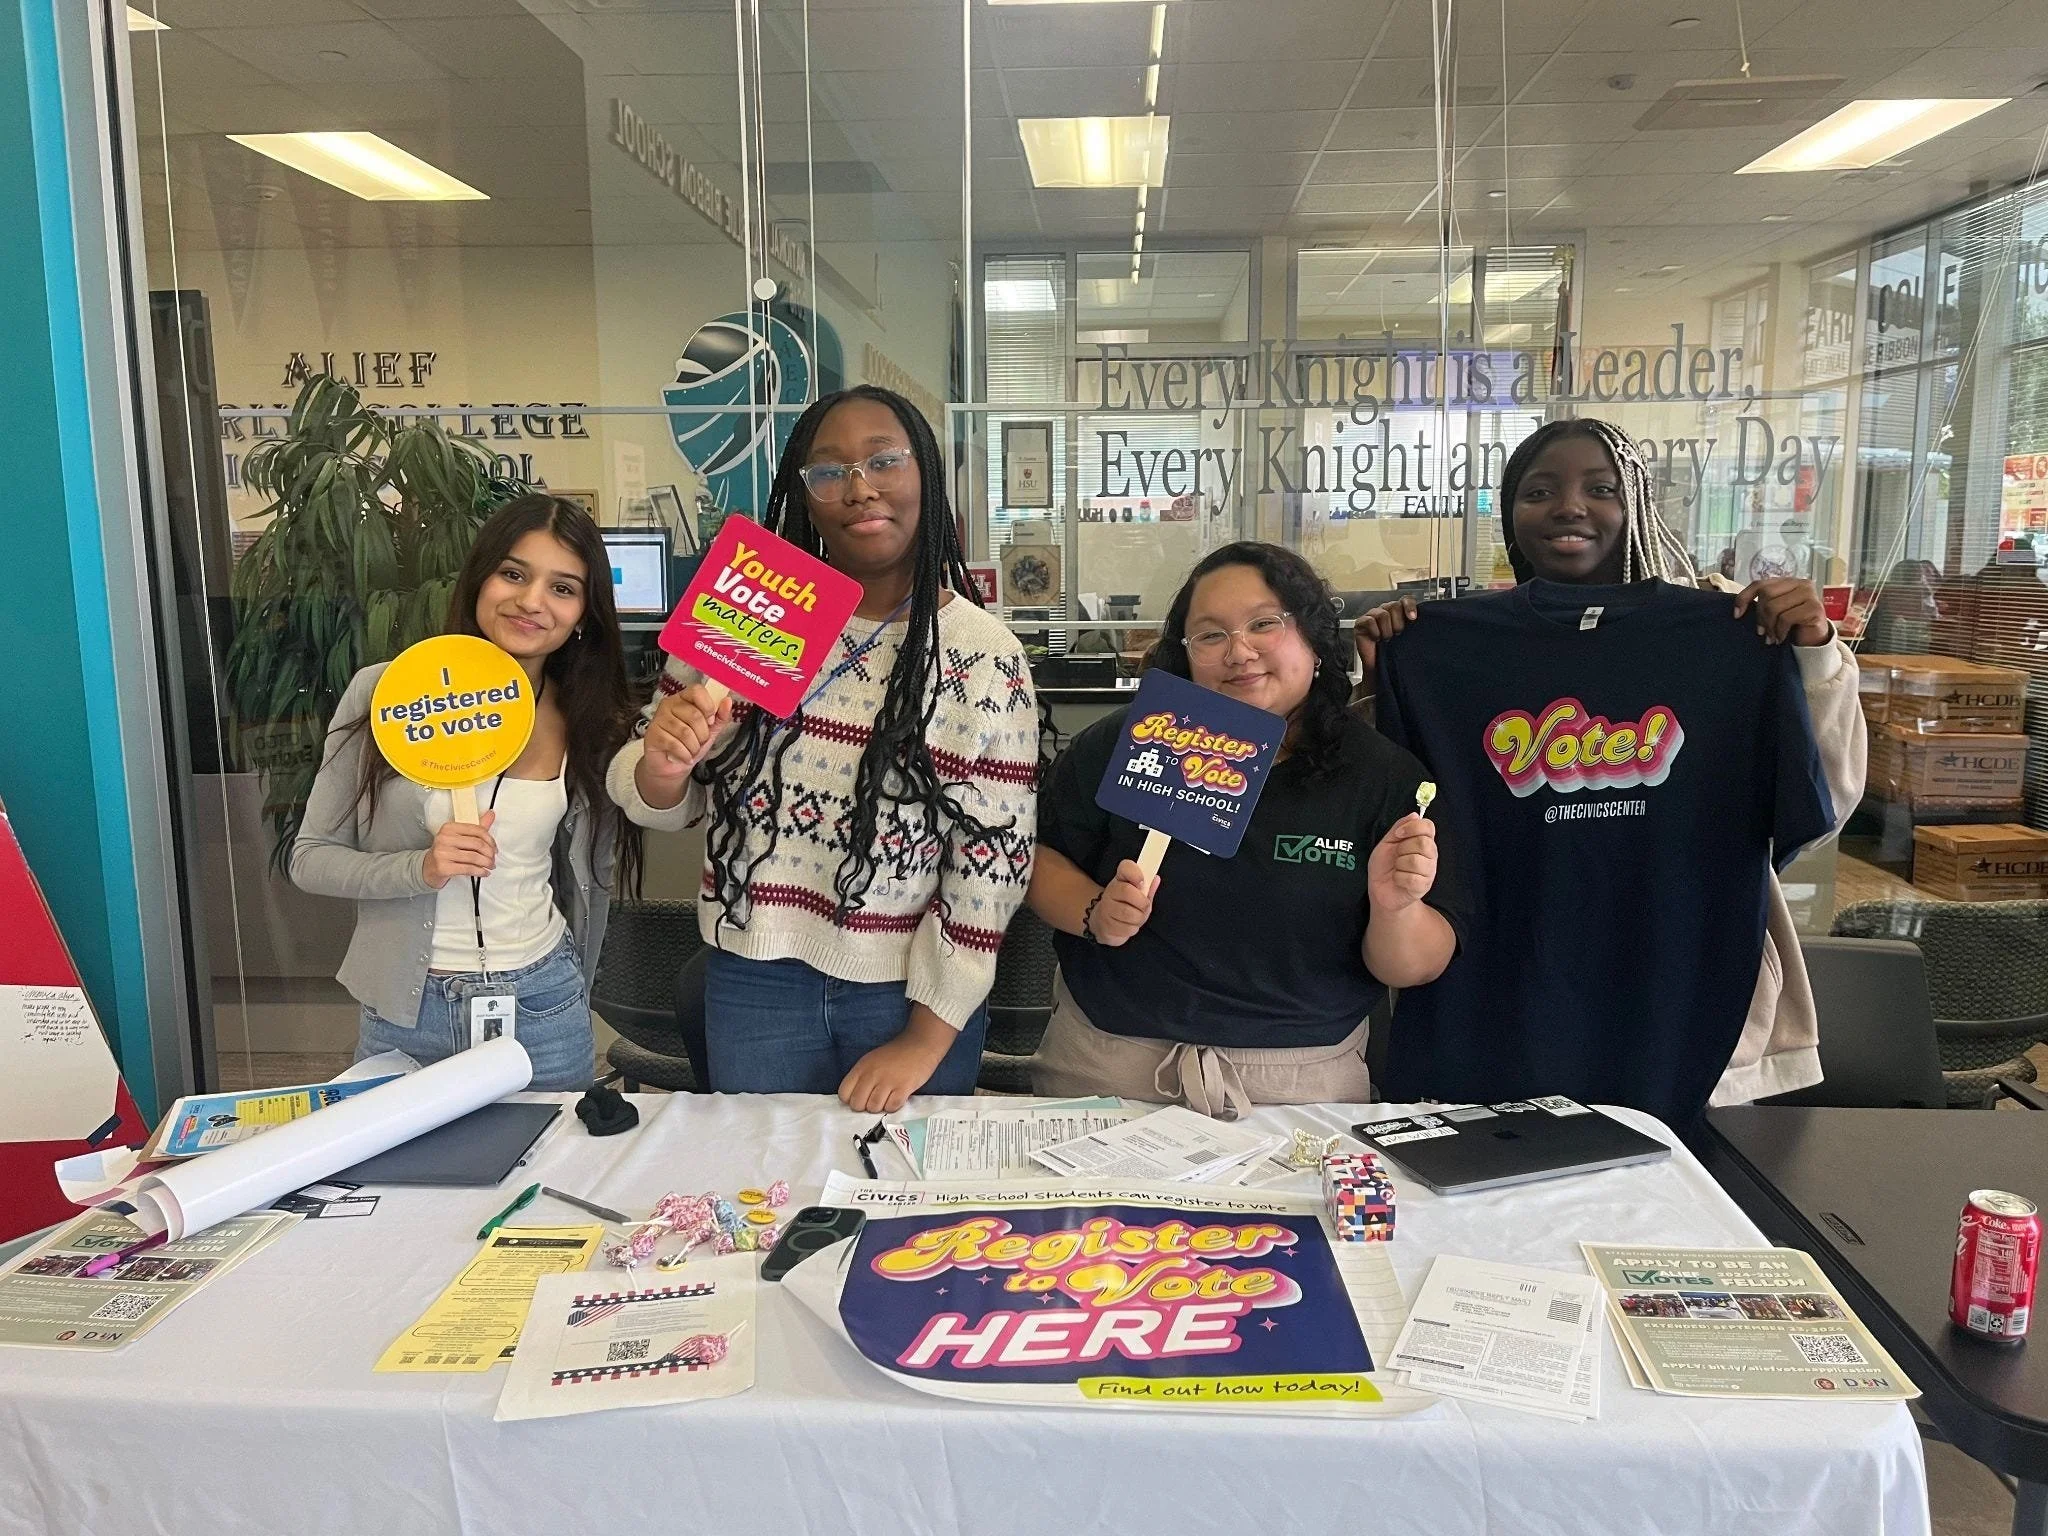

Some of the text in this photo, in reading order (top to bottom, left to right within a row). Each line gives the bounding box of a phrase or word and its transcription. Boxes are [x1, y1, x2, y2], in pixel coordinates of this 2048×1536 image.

[281, 351, 438, 388] ALIEF
[1096, 323, 1756, 430] Every Knight is a Leader,
[1096, 430, 1243, 517] Every
[1258, 418, 1433, 513] Knight
[1729, 415, 1841, 505] Day
[1018, 480, 1038, 489] HSU
[728, 541, 819, 613] Youth
[713, 566, 786, 624] Vote
[702, 595, 799, 661] matters.
[441, 667, 451, 686] I
[693, 640, 771, 688] @thecivicscenter
[379, 679, 521, 723] registered
[1964, 694, 2021, 707] HCDE
[405, 711, 504, 743] to vote
[1131, 712, 1257, 760] Register
[1485, 699, 1677, 785] Vote!
[420, 749, 499, 772] @TheCivicsCenter
[1164, 754, 1245, 792] TO Vote
[1962, 756, 2020, 770] HCDE
[1117, 773, 1242, 814] IN HIGH SCHOOL!
[1543, 799, 1647, 824] @THECIVICSCENTER
[1313, 836, 1355, 852] ALIEF
[856, 1192, 919, 1202] CIVICS
[935, 1189, 1288, 1212] High School Students can register to vote
[88, 1225, 142, 1233] APPL
[874, 1217, 1290, 1276] Register
[1612, 1258, 1790, 1270] APPLY TO BE AN
[1005, 1257, 1284, 1309] to Vote
[1721, 1277, 1807, 1289] FELLOW
[903, 1301, 1249, 1367] HERE
[1714, 1324, 1786, 1332] SEPTEMBER
[1097, 1379, 1361, 1400] Find out how today!
